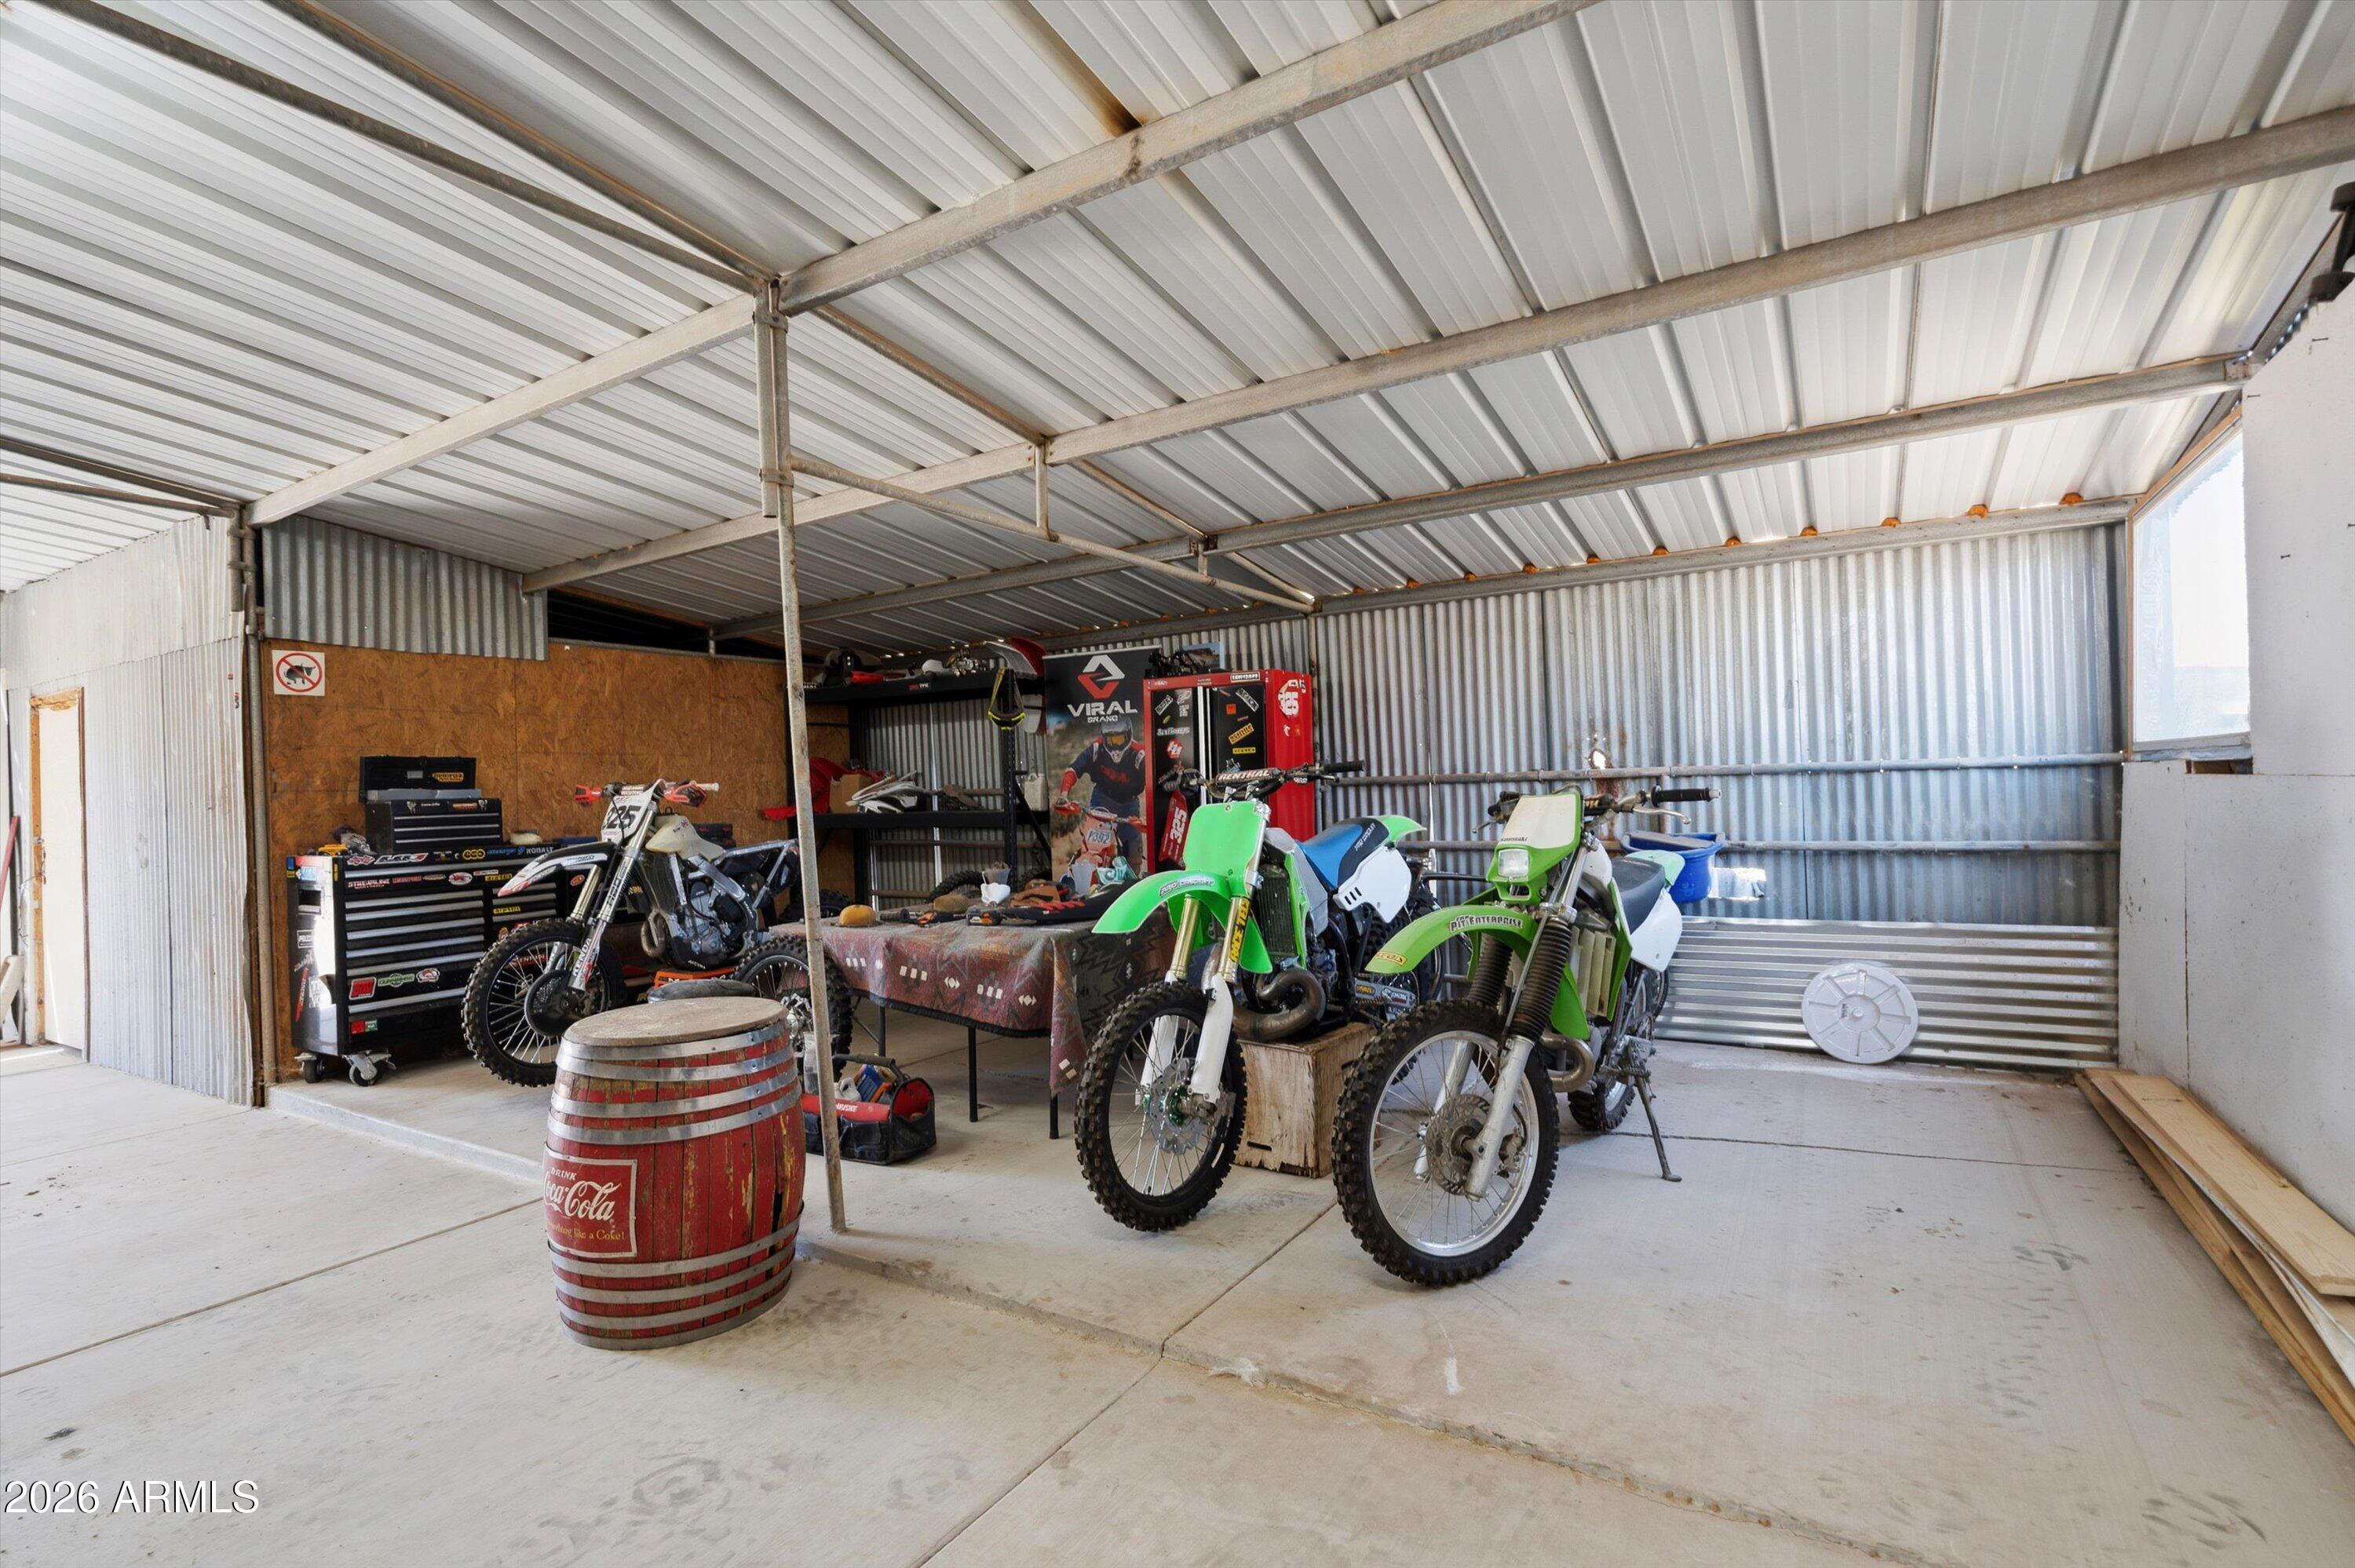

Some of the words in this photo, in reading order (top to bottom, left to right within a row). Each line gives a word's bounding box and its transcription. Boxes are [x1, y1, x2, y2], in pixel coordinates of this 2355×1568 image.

[1067, 700, 1138, 717] VIRAL
[1087, 715, 1119, 724] BRAND
[1218, 769, 1270, 781] RENTHAL
[1170, 807, 1188, 844] 325
[572, 938, 592, 976] KENDA
[550, 1167, 577, 1181] DRINK
